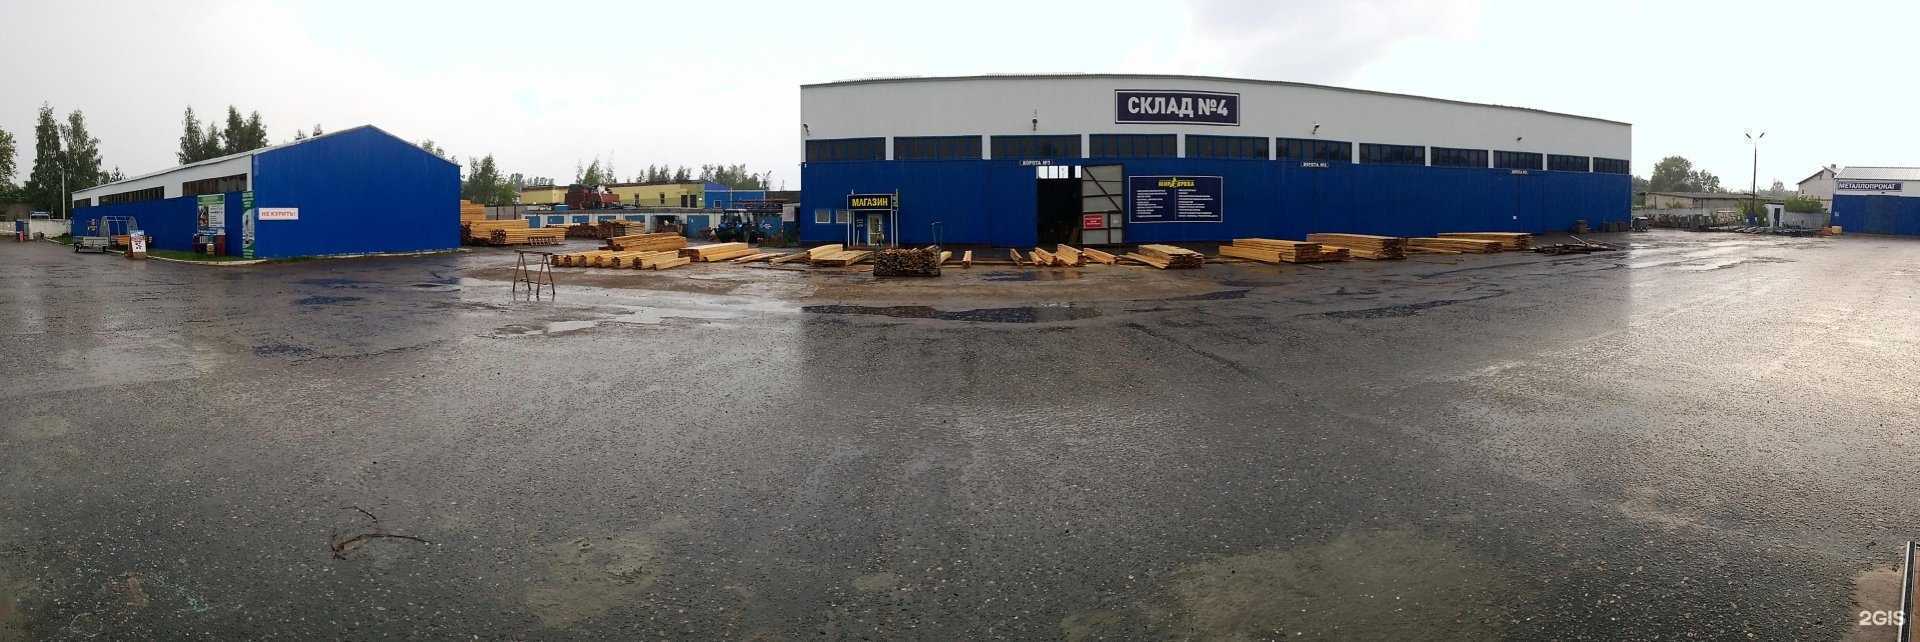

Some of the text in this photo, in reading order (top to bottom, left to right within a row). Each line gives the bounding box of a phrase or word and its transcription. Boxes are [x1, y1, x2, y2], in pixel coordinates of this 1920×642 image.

[1127, 96, 1228, 118] СКЛАД №4
[852, 198, 888, 206] МАГАЗИН
